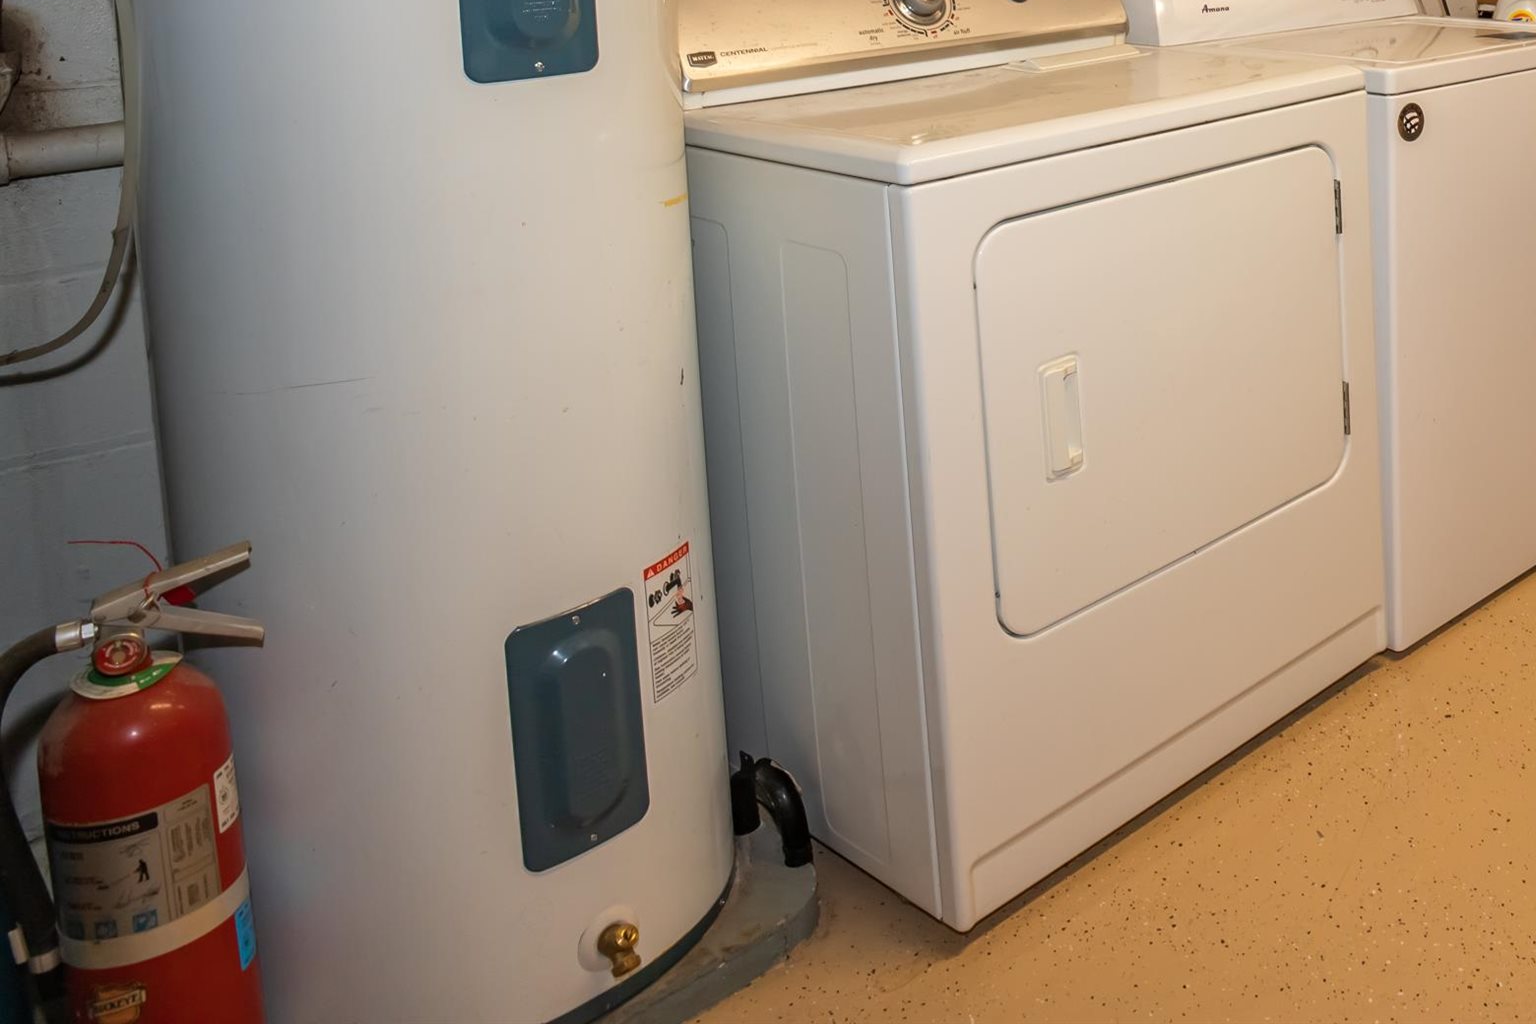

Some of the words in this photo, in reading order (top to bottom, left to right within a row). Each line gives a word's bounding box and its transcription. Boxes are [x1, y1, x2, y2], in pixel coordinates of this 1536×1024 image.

[1202, 4, 1230, 14] Amana
[720, 47, 768, 57] CENTENNIAL
[656, 545, 689, 573] DANGER
